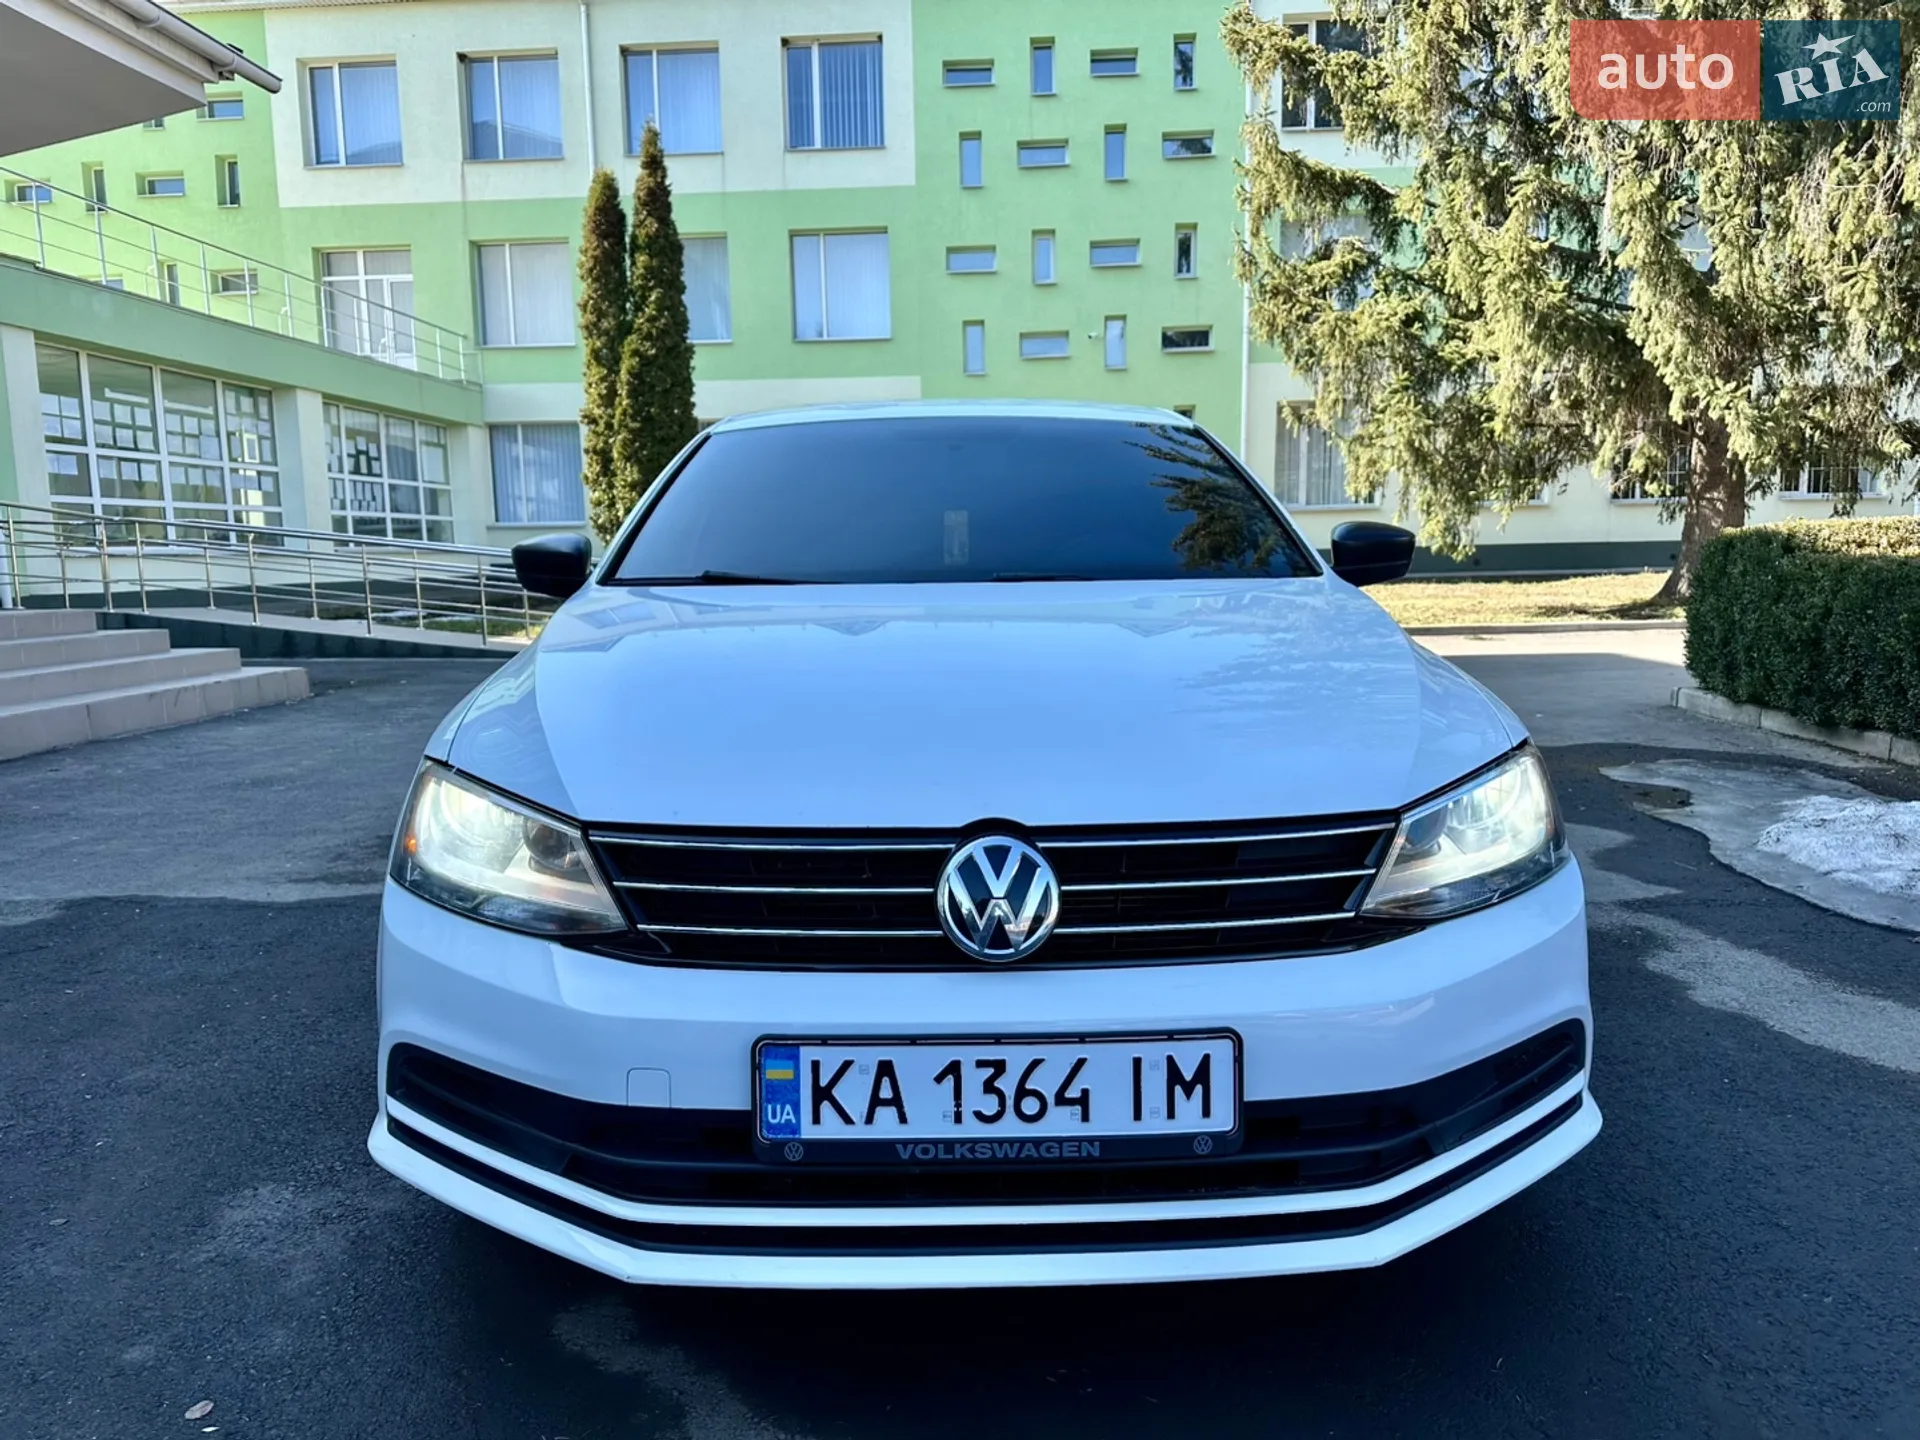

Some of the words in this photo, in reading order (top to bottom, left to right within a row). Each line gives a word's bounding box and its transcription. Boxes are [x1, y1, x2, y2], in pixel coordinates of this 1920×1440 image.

[810, 1058, 908, 1126] KA
[932, 1056, 1091, 1125] 1364
[1131, 1052, 1211, 1122] IM
[766, 1102, 797, 1125] UA
[895, 1140, 1101, 1160] VOLKSWAGEN
